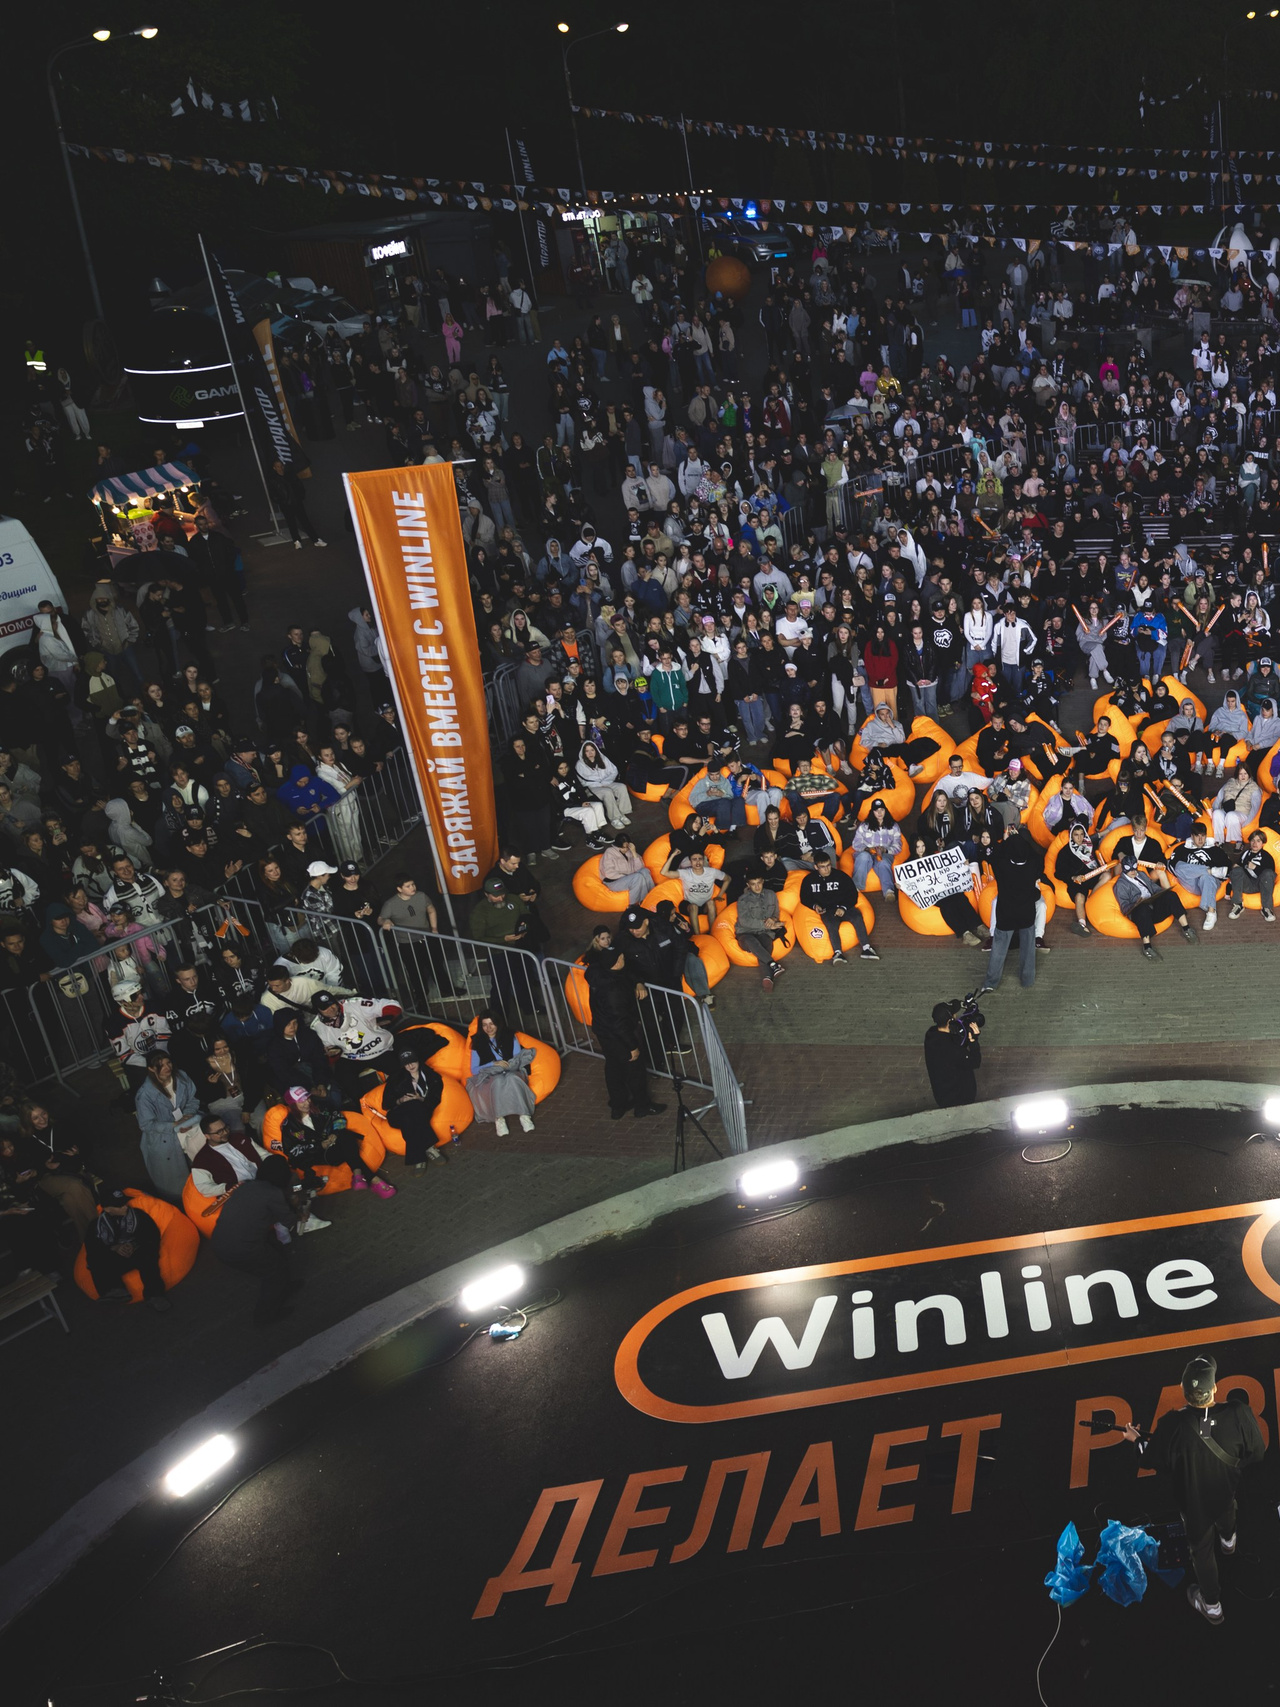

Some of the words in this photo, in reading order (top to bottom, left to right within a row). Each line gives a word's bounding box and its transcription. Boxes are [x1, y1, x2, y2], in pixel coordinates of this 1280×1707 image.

[391, 490, 440, 610] WINLINE
[0, 617, 35, 637] ПОМО
[416, 645, 463, 748] ВМЕСТЕ
[428, 758, 481, 880] ЗАРЯЖАЙ
[895, 849, 962, 881] ИВАНОВЫ
[811, 881, 839, 893] NIKE
[701, 1258, 1218, 1380] Winline
[471, 1413, 1002, 1620] ДЕЛАЕТ
